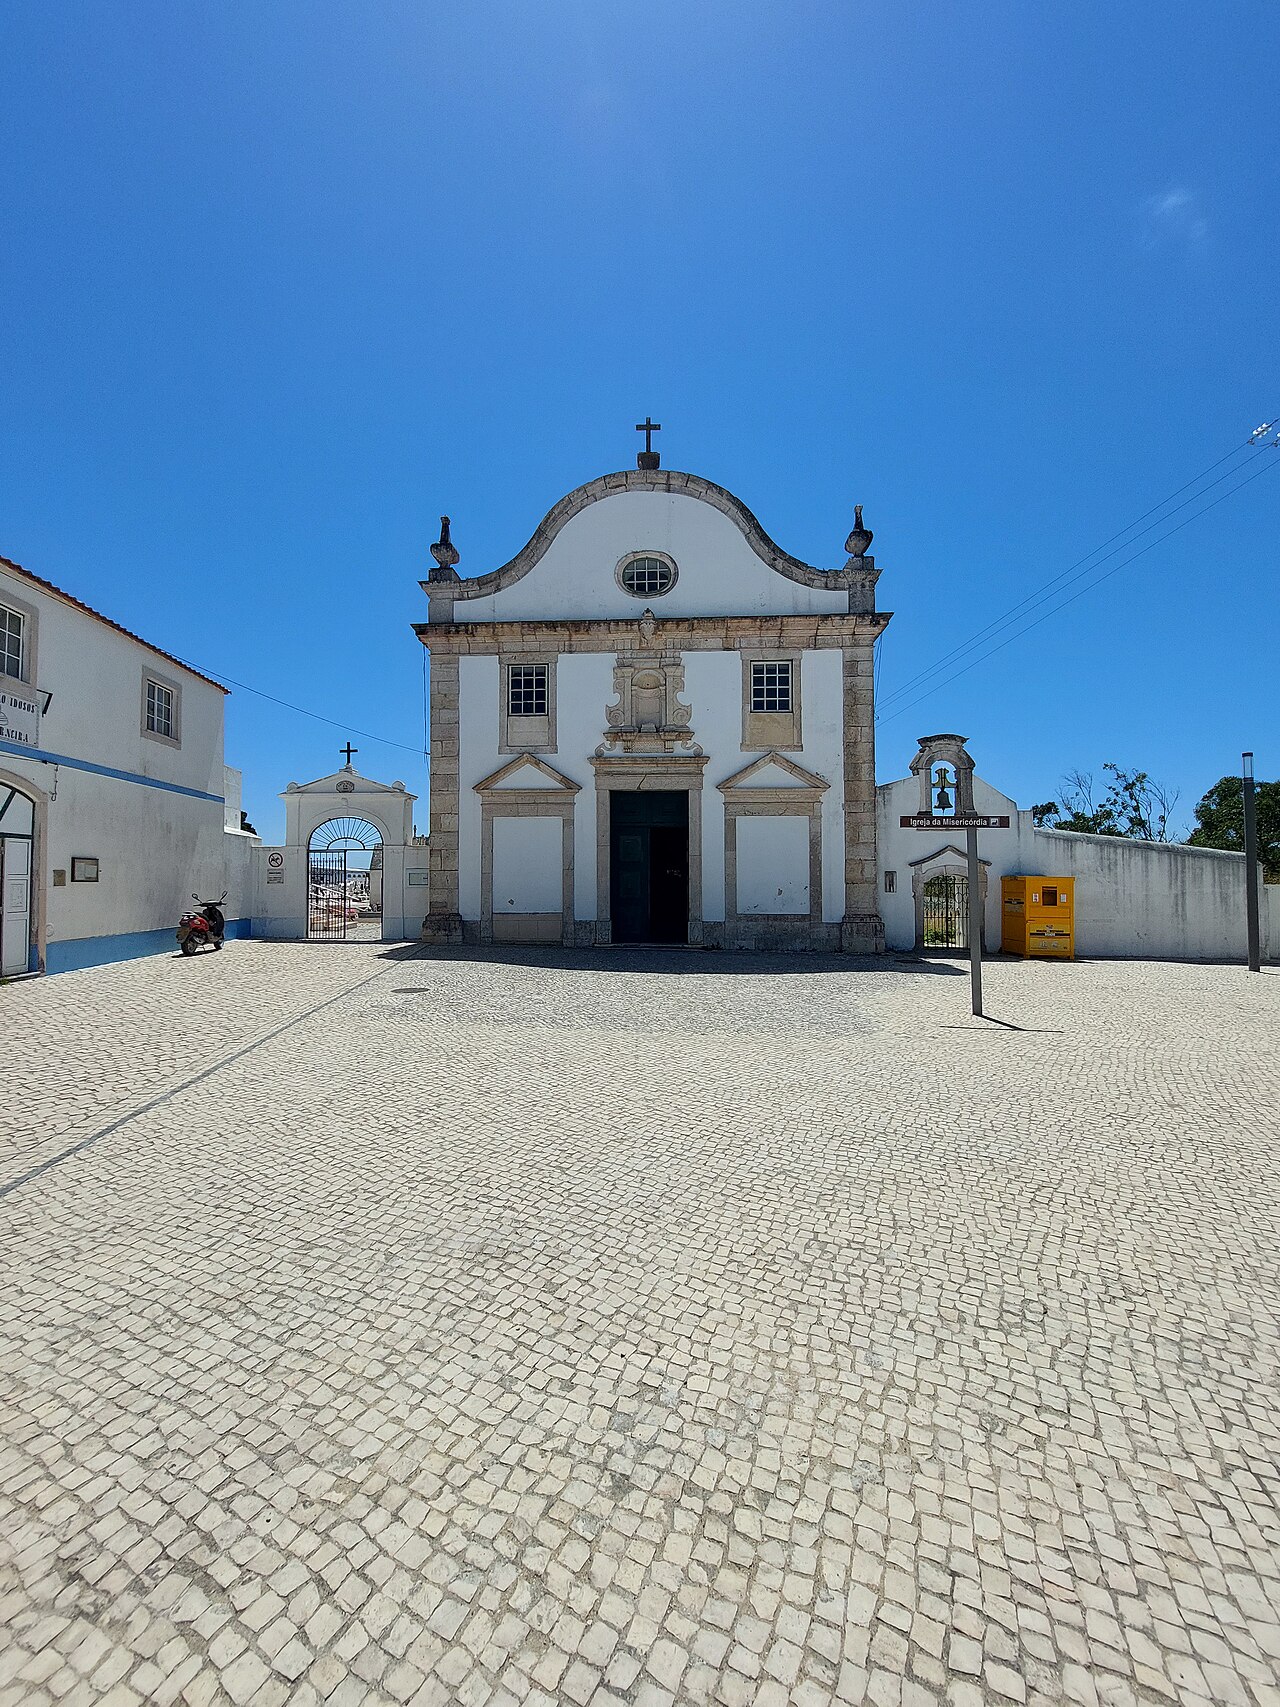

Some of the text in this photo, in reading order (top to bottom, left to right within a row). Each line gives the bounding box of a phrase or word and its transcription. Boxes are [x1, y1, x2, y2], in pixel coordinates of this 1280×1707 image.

[10, 697, 35, 713] IDOSOS
[910, 817, 988, 827] Igreja da Misericórdia
